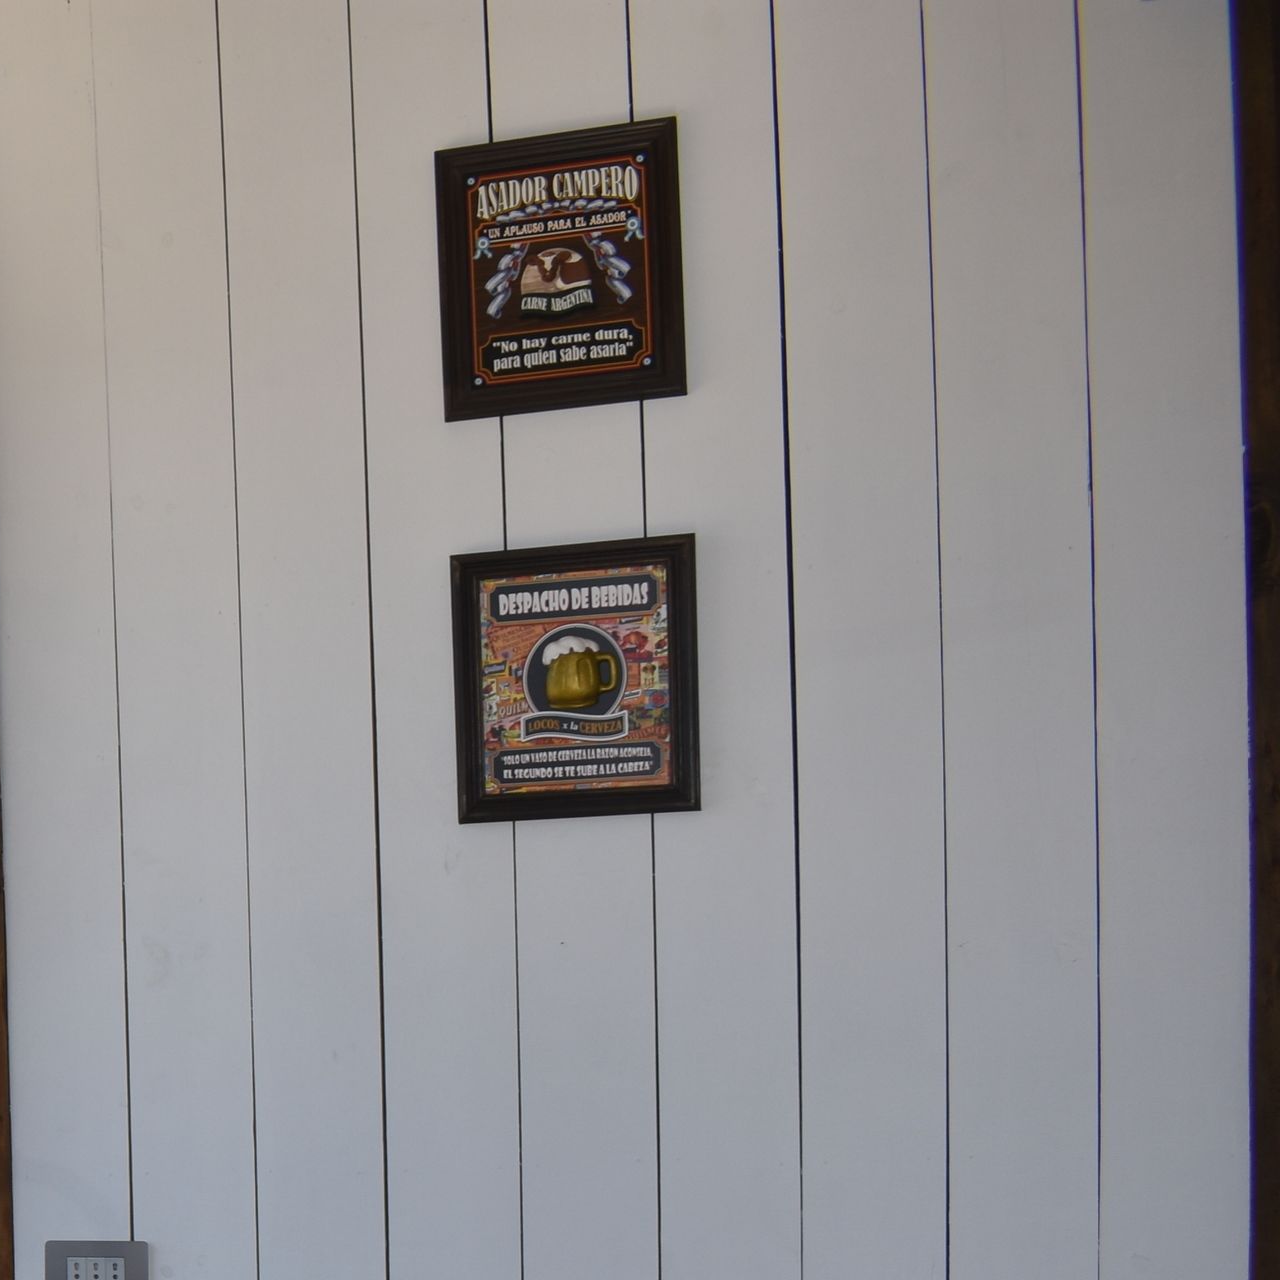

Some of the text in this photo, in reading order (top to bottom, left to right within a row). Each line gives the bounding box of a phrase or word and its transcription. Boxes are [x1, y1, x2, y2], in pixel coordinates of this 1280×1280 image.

[477, 165, 639, 219] ASADOR CAMPERO
[503, 221, 544, 237] APLAUSO
[547, 218, 572, 231] PARA
[575, 217, 587, 228] EL
[521, 288, 593, 312] CARNE ARGENTINA
[492, 328, 633, 353] "No hay carne dura,
[493, 341, 634, 372] para quien sabe asarla"
[498, 582, 648, 616] DESPACHO DE BEBIDAS
[527, 719, 560, 731] LOCOS
[570, 721, 578, 730] la
[580, 720, 622, 734] CERVEZA
[520, 753, 530, 764] UN
[548, 750, 557, 762] DE
[558, 748, 586, 761] CERVEZA
[587, 748, 595, 759] LA
[503, 769, 513, 779] EL
[514, 767, 552, 779] SEGUNDO
[553, 766, 563, 777] SE
[564, 765, 575, 777] TE
[576, 764, 598, 776] SUBE
[599, 763, 605, 775] A
[606, 763, 616, 774] LA
